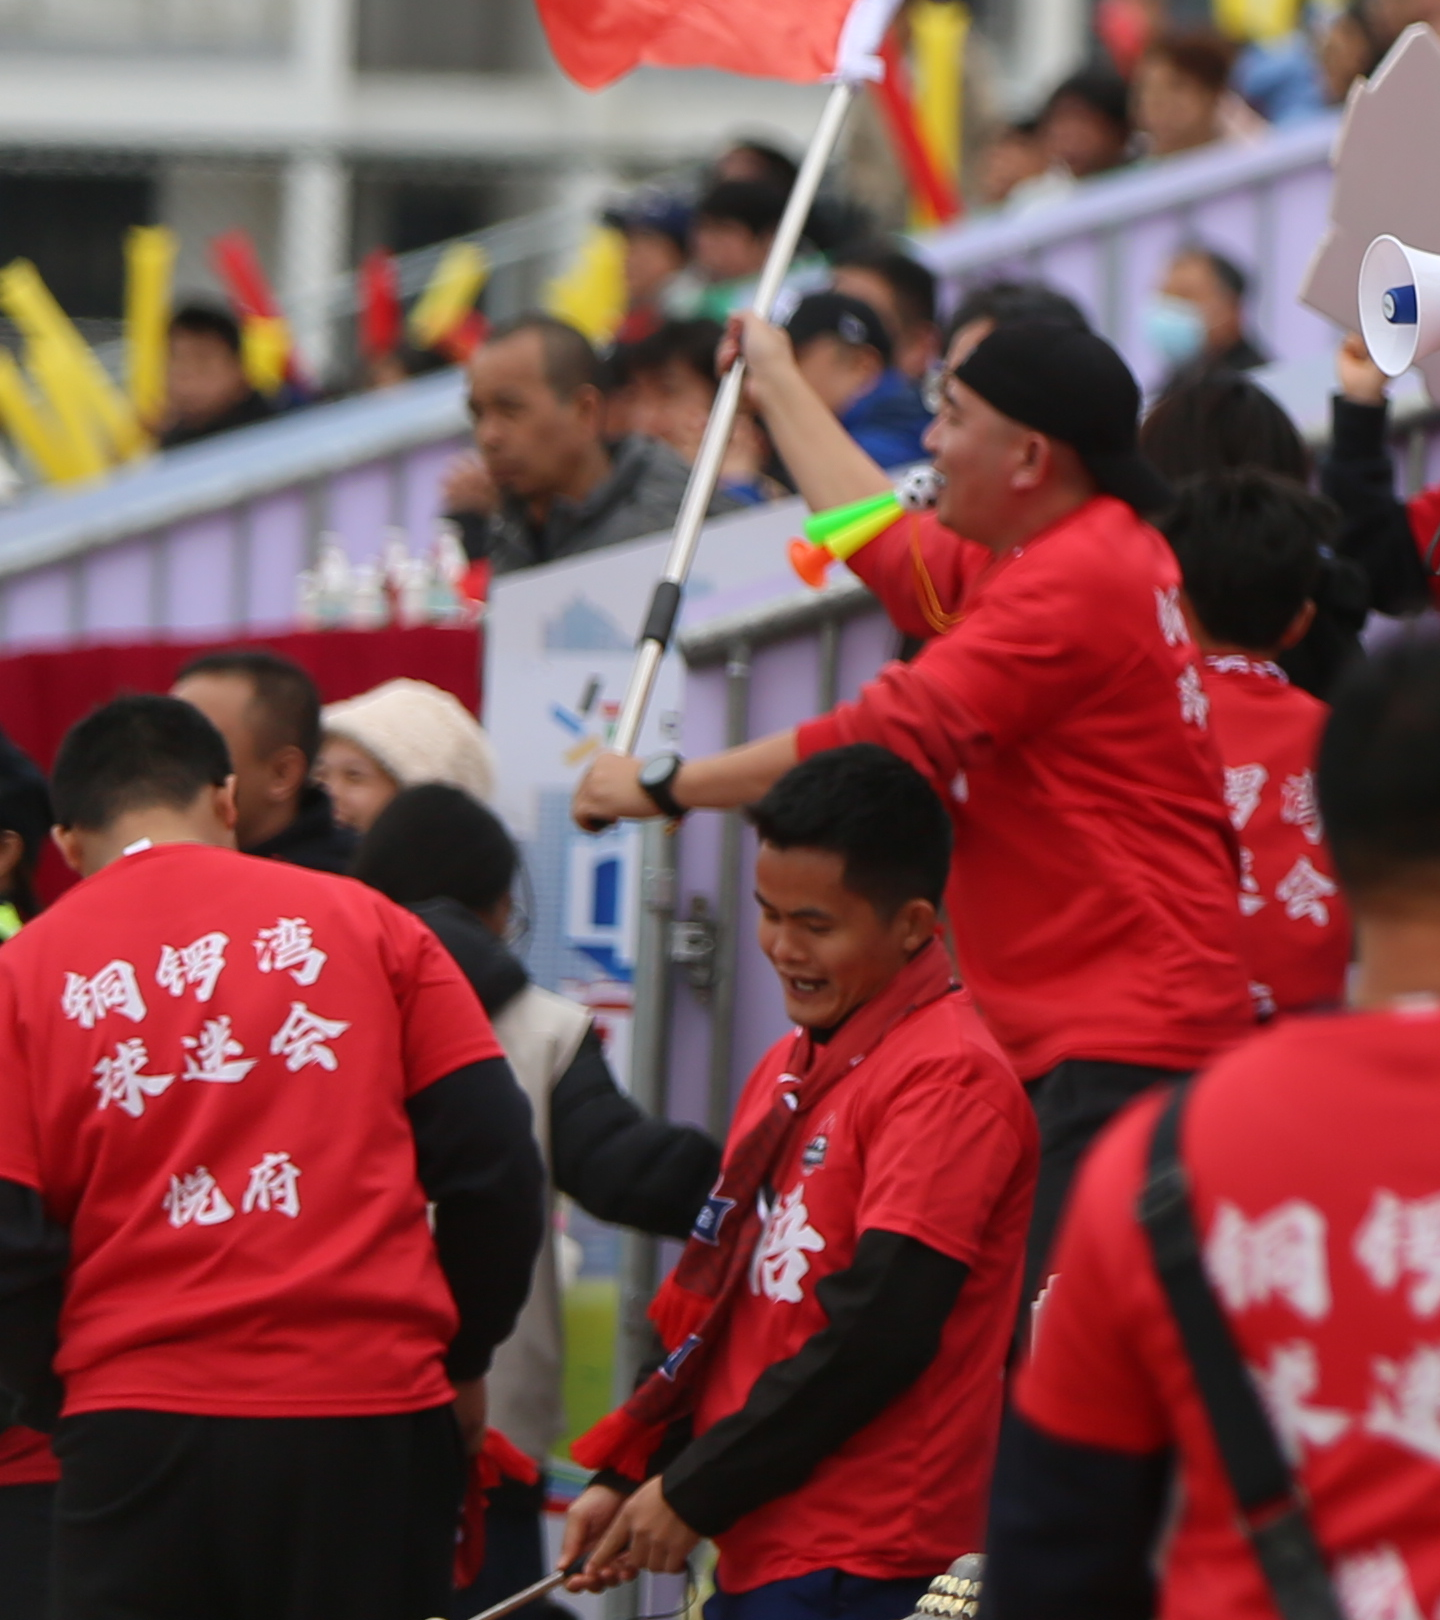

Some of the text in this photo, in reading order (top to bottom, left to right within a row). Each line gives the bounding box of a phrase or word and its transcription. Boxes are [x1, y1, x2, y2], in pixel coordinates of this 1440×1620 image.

[60, 915, 329, 1029] 铜锣湾
[91, 1000, 352, 1118] 球迷会
[163, 1151, 304, 1229] 悦府
